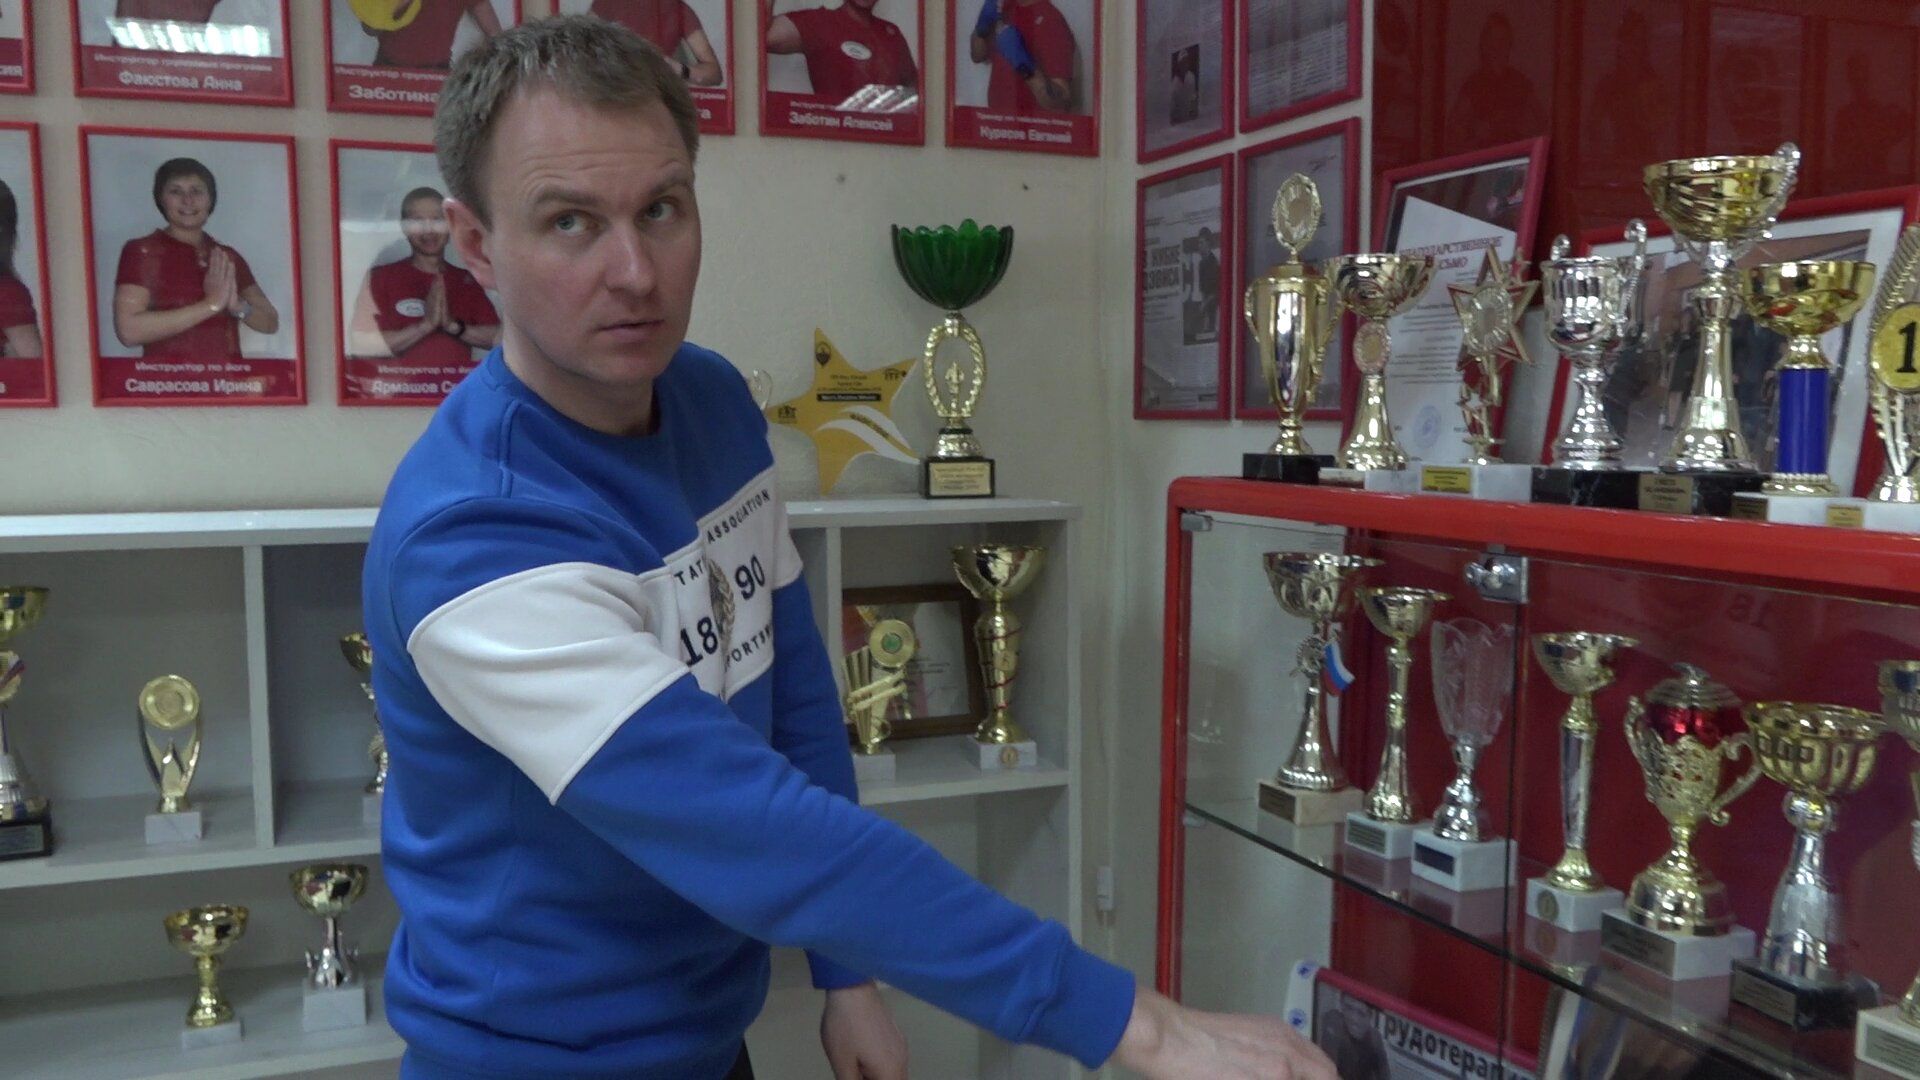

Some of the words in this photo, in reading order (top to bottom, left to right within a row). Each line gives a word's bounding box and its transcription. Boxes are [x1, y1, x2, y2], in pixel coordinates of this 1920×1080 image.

[203, 75, 243, 91] Анна
[1895, 321, 1918, 373] 1
[213, 378, 263, 395] Ирина
[706, 488, 771, 545] ASSOCIATION
[680, 616, 719, 667] 18
[734, 555, 766, 601] 90
[1372, 1009, 1536, 1080] рудотерап
